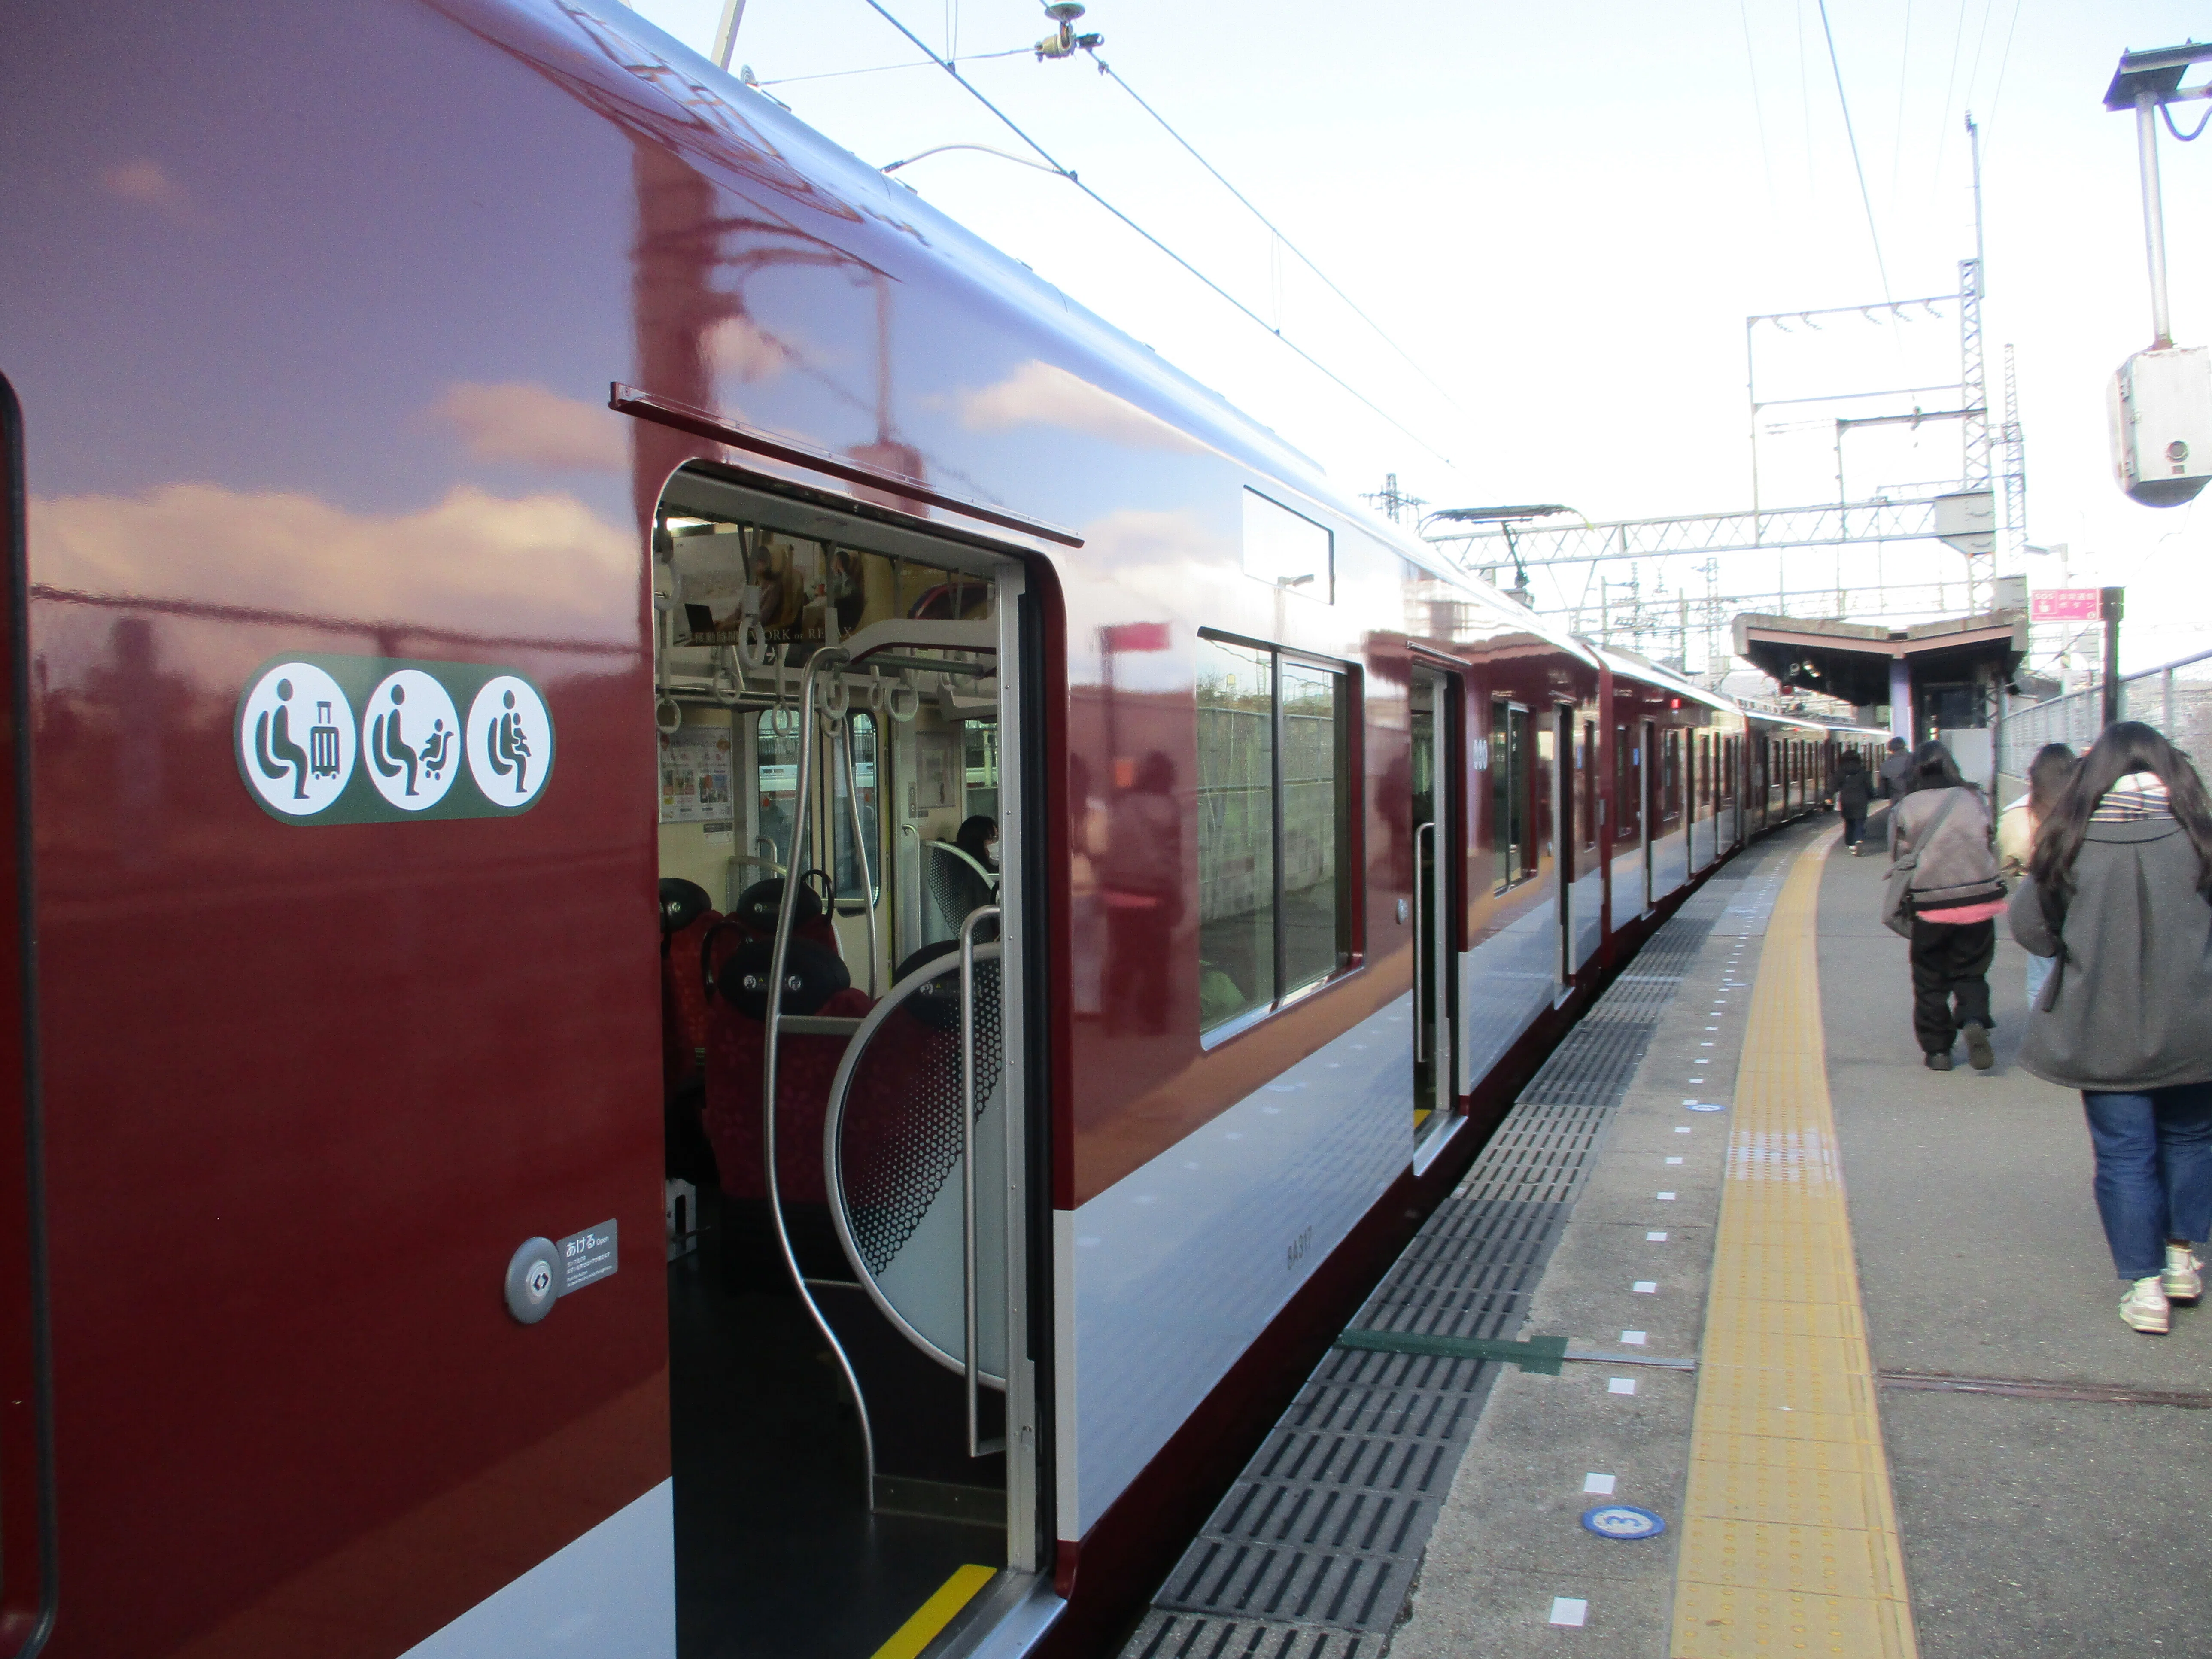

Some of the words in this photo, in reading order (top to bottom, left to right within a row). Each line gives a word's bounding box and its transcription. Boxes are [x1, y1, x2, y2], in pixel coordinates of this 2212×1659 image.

[808, 627, 851, 639] REX
[566, 1233, 595, 1258] あける
[596, 1236, 609, 1246] Open
